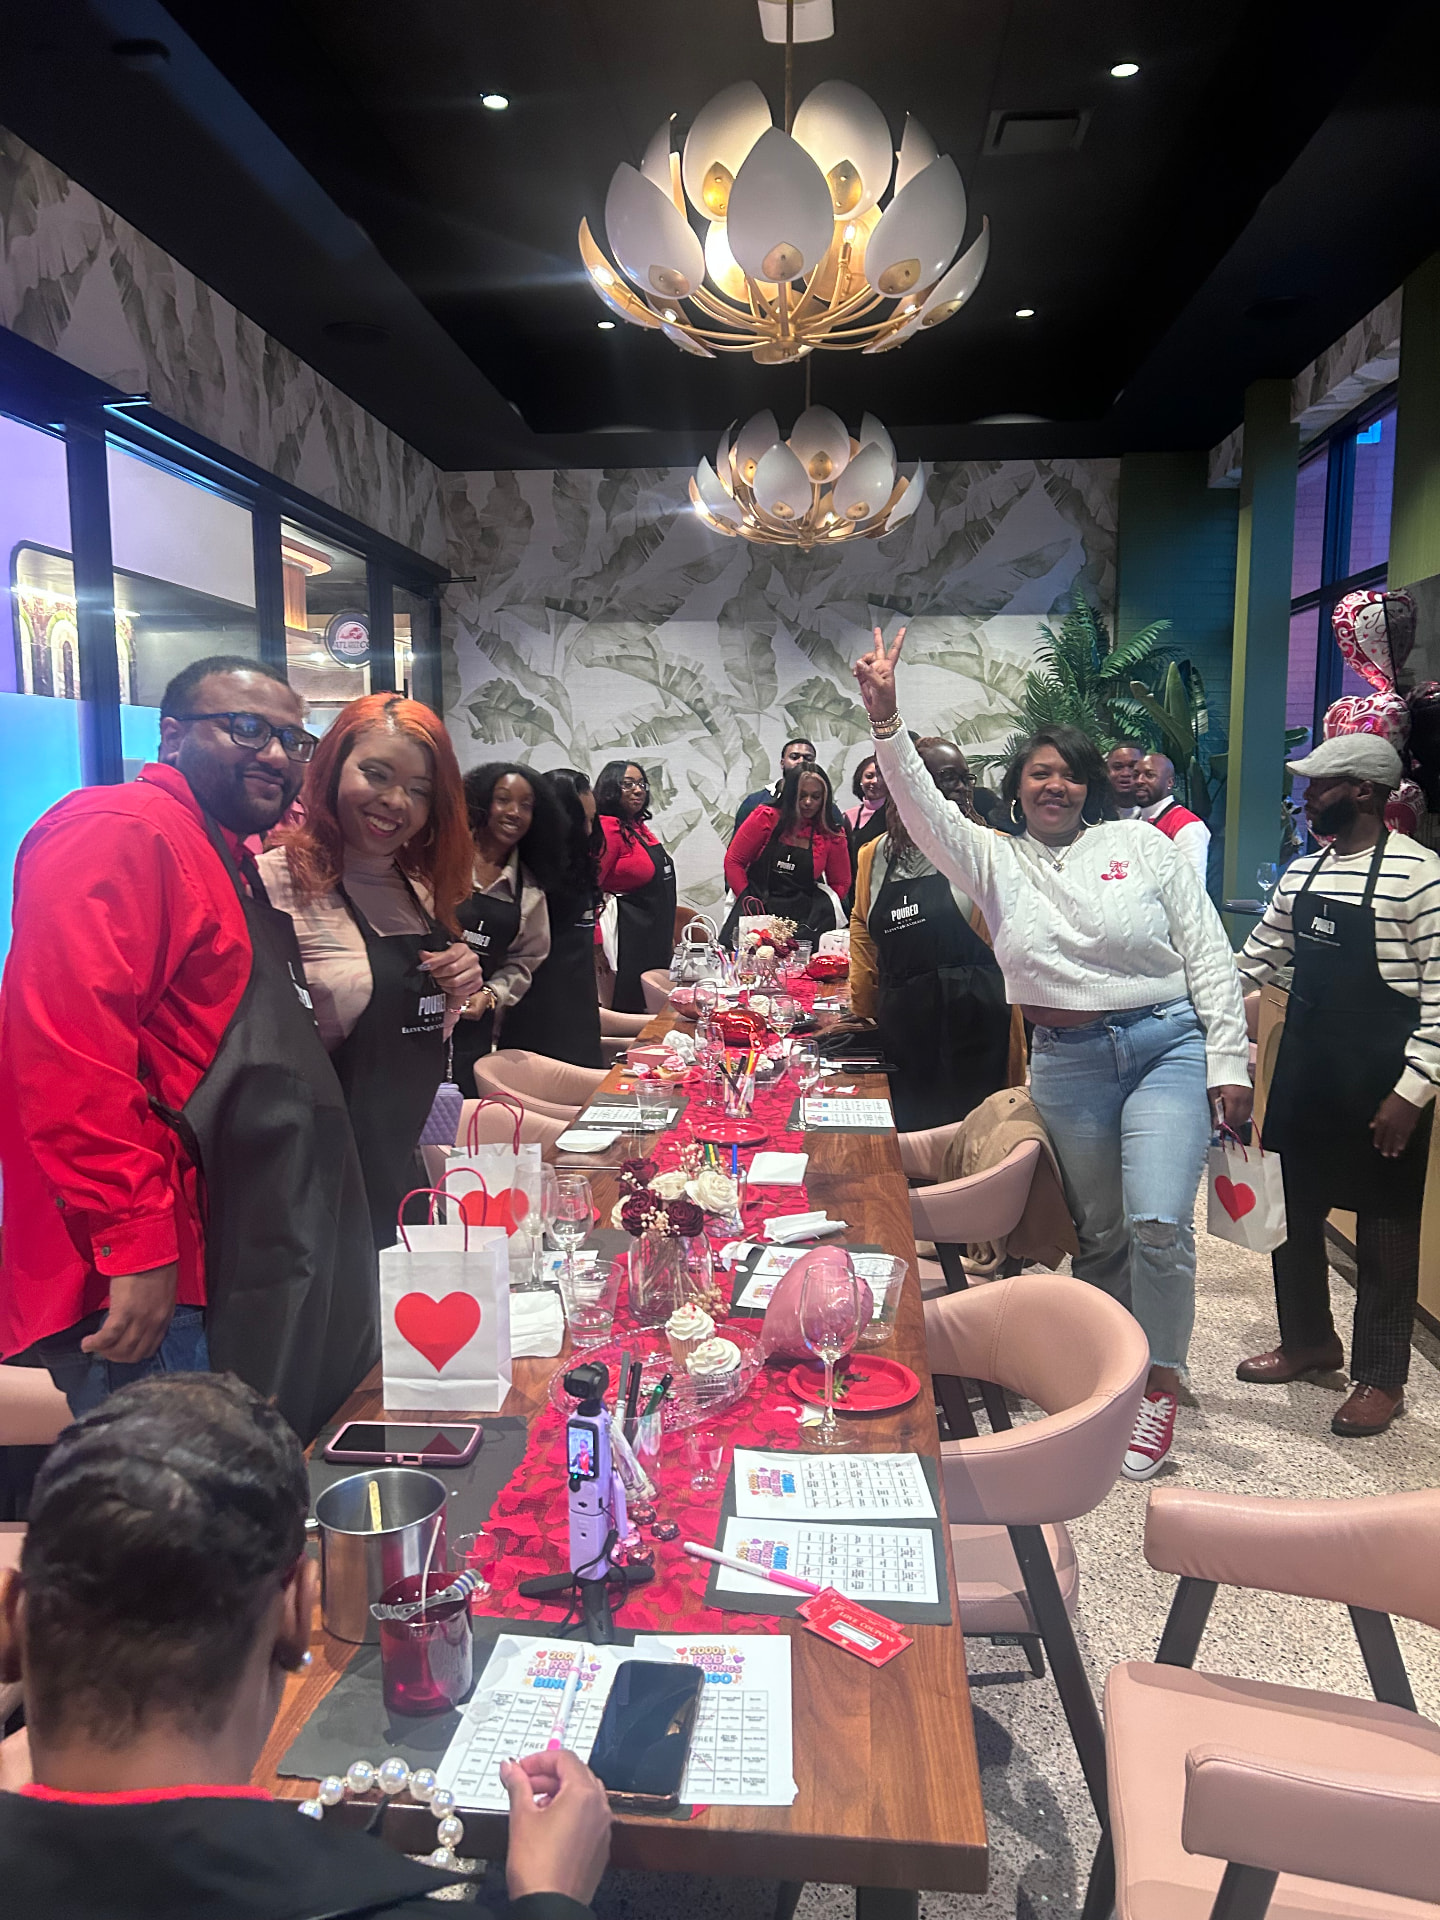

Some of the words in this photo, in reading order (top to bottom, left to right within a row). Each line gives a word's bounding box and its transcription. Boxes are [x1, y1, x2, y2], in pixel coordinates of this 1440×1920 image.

[903, 895, 908, 905] I
[890, 903, 919, 922] POURED
[418, 993, 447, 1016] POURE
[838, 1611, 859, 1624] LOVE
[859, 1622, 896, 1643] COUPONS
[689, 1646, 727, 1656] 2000s
[692, 1654, 725, 1665] R&B
[527, 1667, 557, 1677] LOVE
[557, 1669, 597, 1682] SGS
[703, 1664, 743, 1674] SONGS
[532, 1675, 584, 1692] BIN
[523, 1741, 545, 1750] FREE
